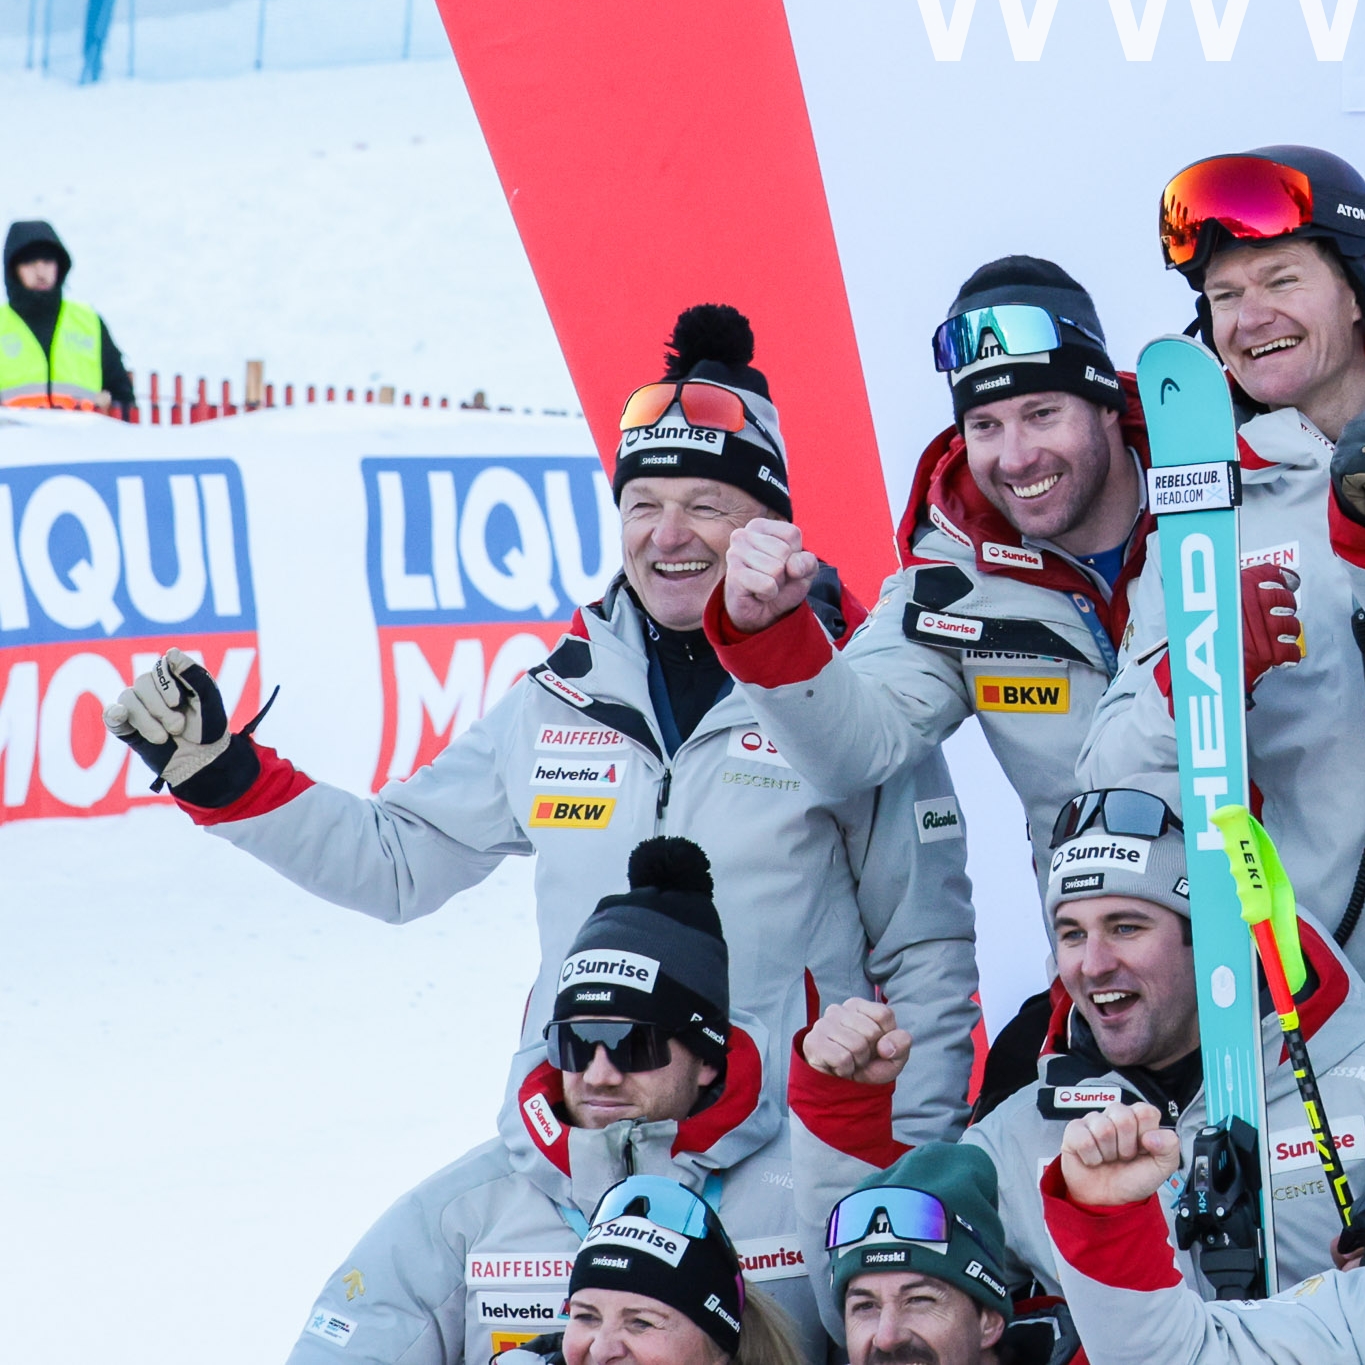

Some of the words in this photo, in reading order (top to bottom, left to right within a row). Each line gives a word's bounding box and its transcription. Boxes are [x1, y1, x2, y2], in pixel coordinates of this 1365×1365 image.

[642, 426, 718, 445] Sunrise
[1155, 470, 1221, 489] REBELSCLUB.
[1156, 488, 1203, 506] HEAD.COM
[1002, 549, 1039, 565] Sunrise
[937, 620, 976, 635] Sunrise
[1003, 686, 1060, 705] BKW
[1180, 532, 1228, 851] HEAD
[535, 766, 598, 781] helvetia
[553, 803, 605, 821] BKW
[922, 811, 957, 830] Ricola
[1066, 840, 1140, 863] Sunrise
[1239, 840, 1263, 890] LEKI
[1064, 875, 1099, 890] swissski
[574, 959, 649, 982] Sunrise
[1073, 1092, 1116, 1104] Sunrise
[534, 1107, 555, 1138] Sunrise
[603, 1223, 678, 1254] Sunrise
[866, 1251, 905, 1265] swissski
[979, 1270, 1006, 1297] reusch
[481, 1301, 554, 1320] helvetia
